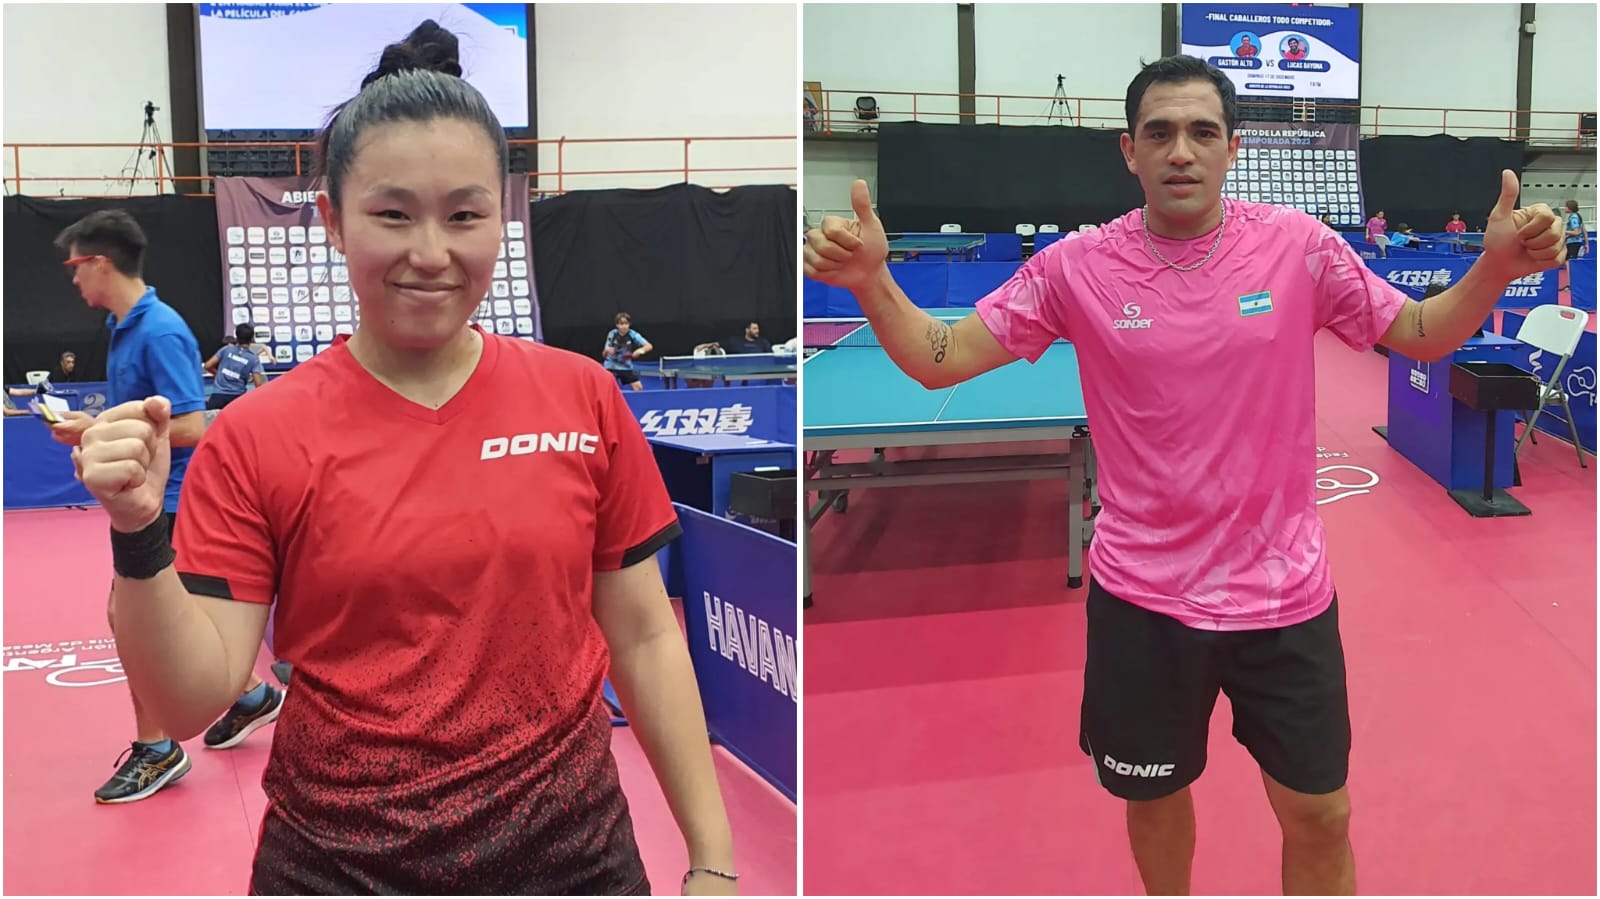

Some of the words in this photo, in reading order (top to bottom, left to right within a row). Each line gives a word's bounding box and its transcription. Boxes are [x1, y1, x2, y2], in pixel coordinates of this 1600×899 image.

[1229, 14, 1271, 24] CABALLEROS
[1273, 16, 1290, 24] TODO
[1265, 59, 1275, 68] VS
[1271, 129, 1281, 137] LA
[1282, 128, 1326, 138] REPÚBLICA
[281, 191, 320, 204] ABIE
[1504, 286, 1542, 297] DHS
[640, 403, 754, 436] 红双喜
[480, 431, 599, 460] DONIC
[704, 591, 797, 704] HAVAN
[1103, 754, 1176, 778] DONIC
